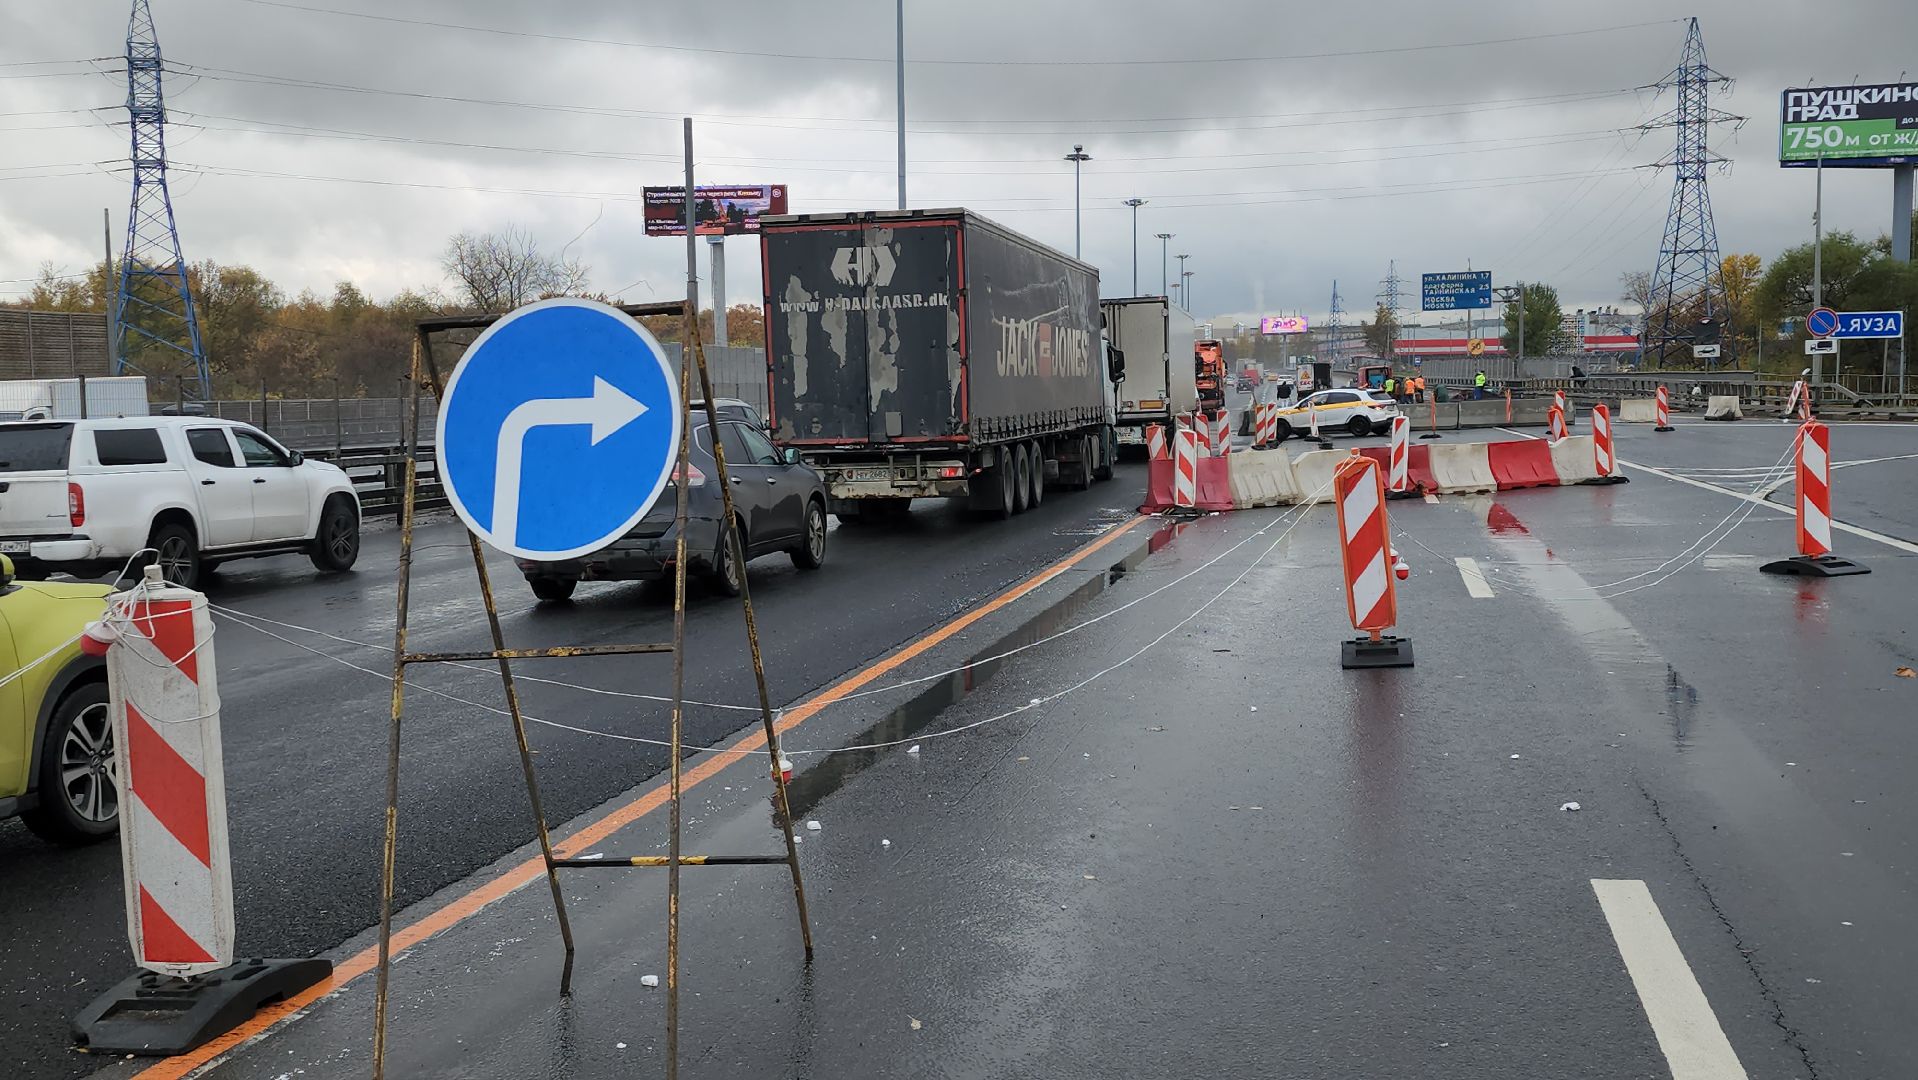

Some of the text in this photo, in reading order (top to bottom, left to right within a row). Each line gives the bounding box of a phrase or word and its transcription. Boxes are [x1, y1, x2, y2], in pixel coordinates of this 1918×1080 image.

[1788, 86, 1918, 106] ПУШКИН
[1787, 104, 1859, 122] ГРАД
[1894, 130, 1918, 146] Ж/
[1848, 317, 1897, 332] ЯУЗА
[996, 315, 1038, 377] JACK
[1052, 326, 1089, 378] JONES
